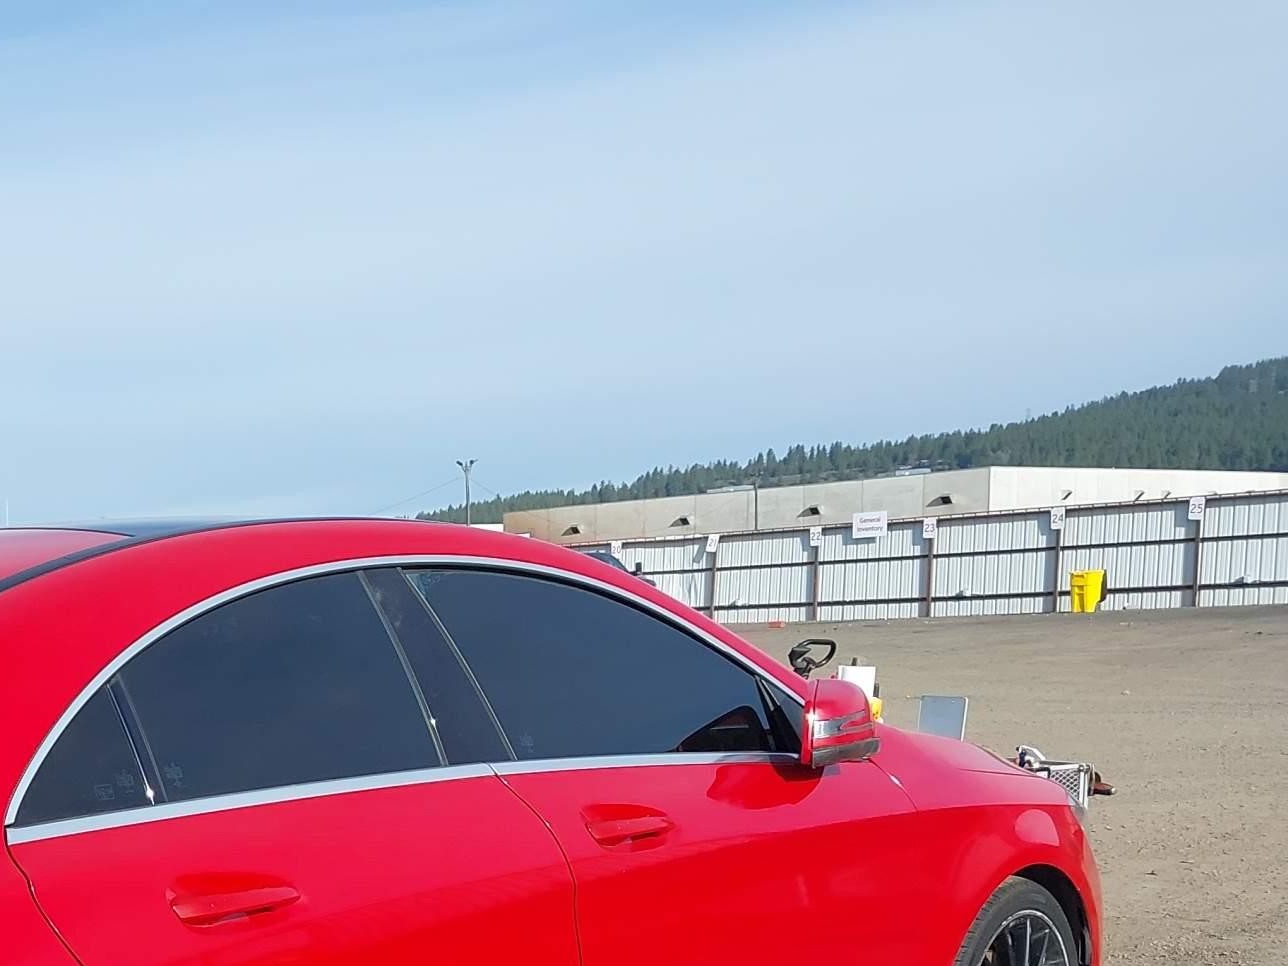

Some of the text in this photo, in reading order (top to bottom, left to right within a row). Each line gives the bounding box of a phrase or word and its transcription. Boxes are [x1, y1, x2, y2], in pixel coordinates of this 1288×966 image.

[1190, 504, 1203, 514] 25
[1052, 513, 1064, 524] 24
[924, 523, 936, 533] 23
[810, 531, 821, 541] 22
